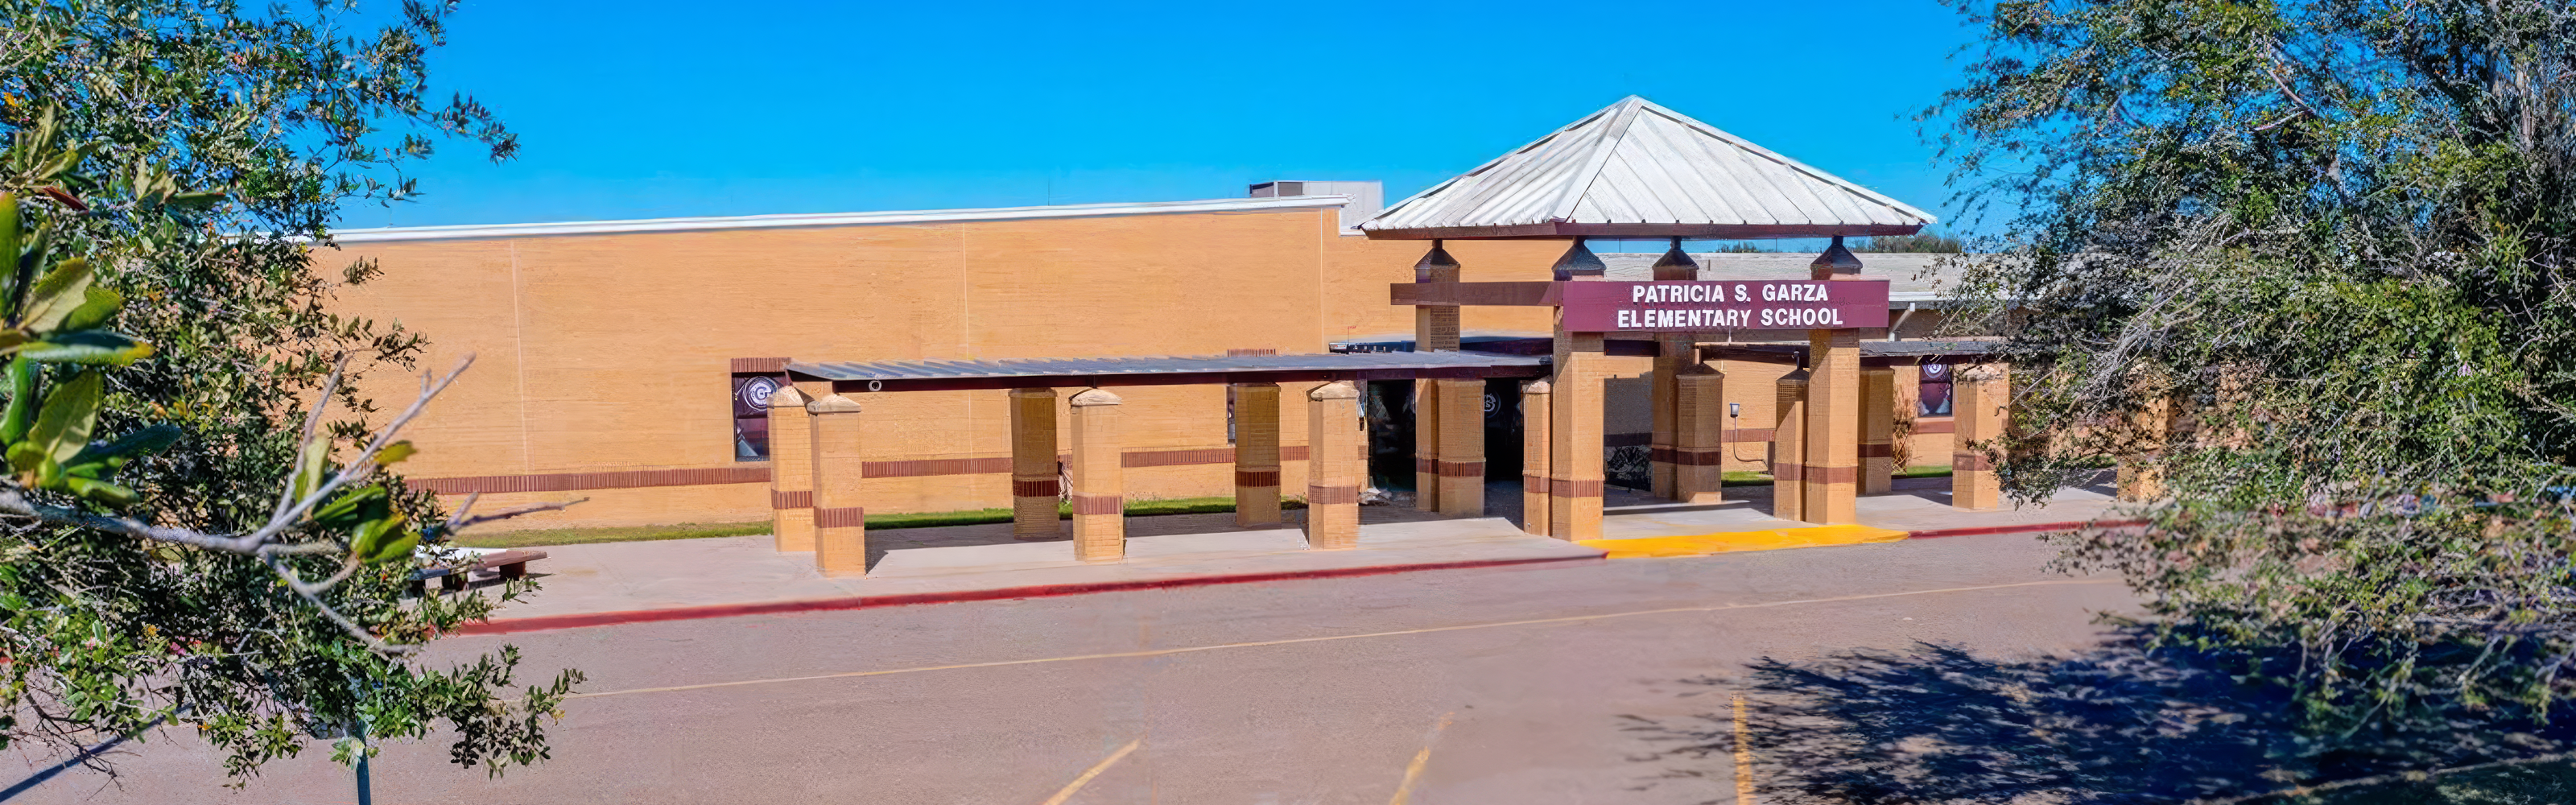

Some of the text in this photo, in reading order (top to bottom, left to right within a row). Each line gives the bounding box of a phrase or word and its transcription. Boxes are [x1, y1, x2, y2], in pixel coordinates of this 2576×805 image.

[1633, 283, 1829, 303] PATRICIA S. GARZA
[1617, 308, 1844, 328] ELEMENTARY SCHOOL
